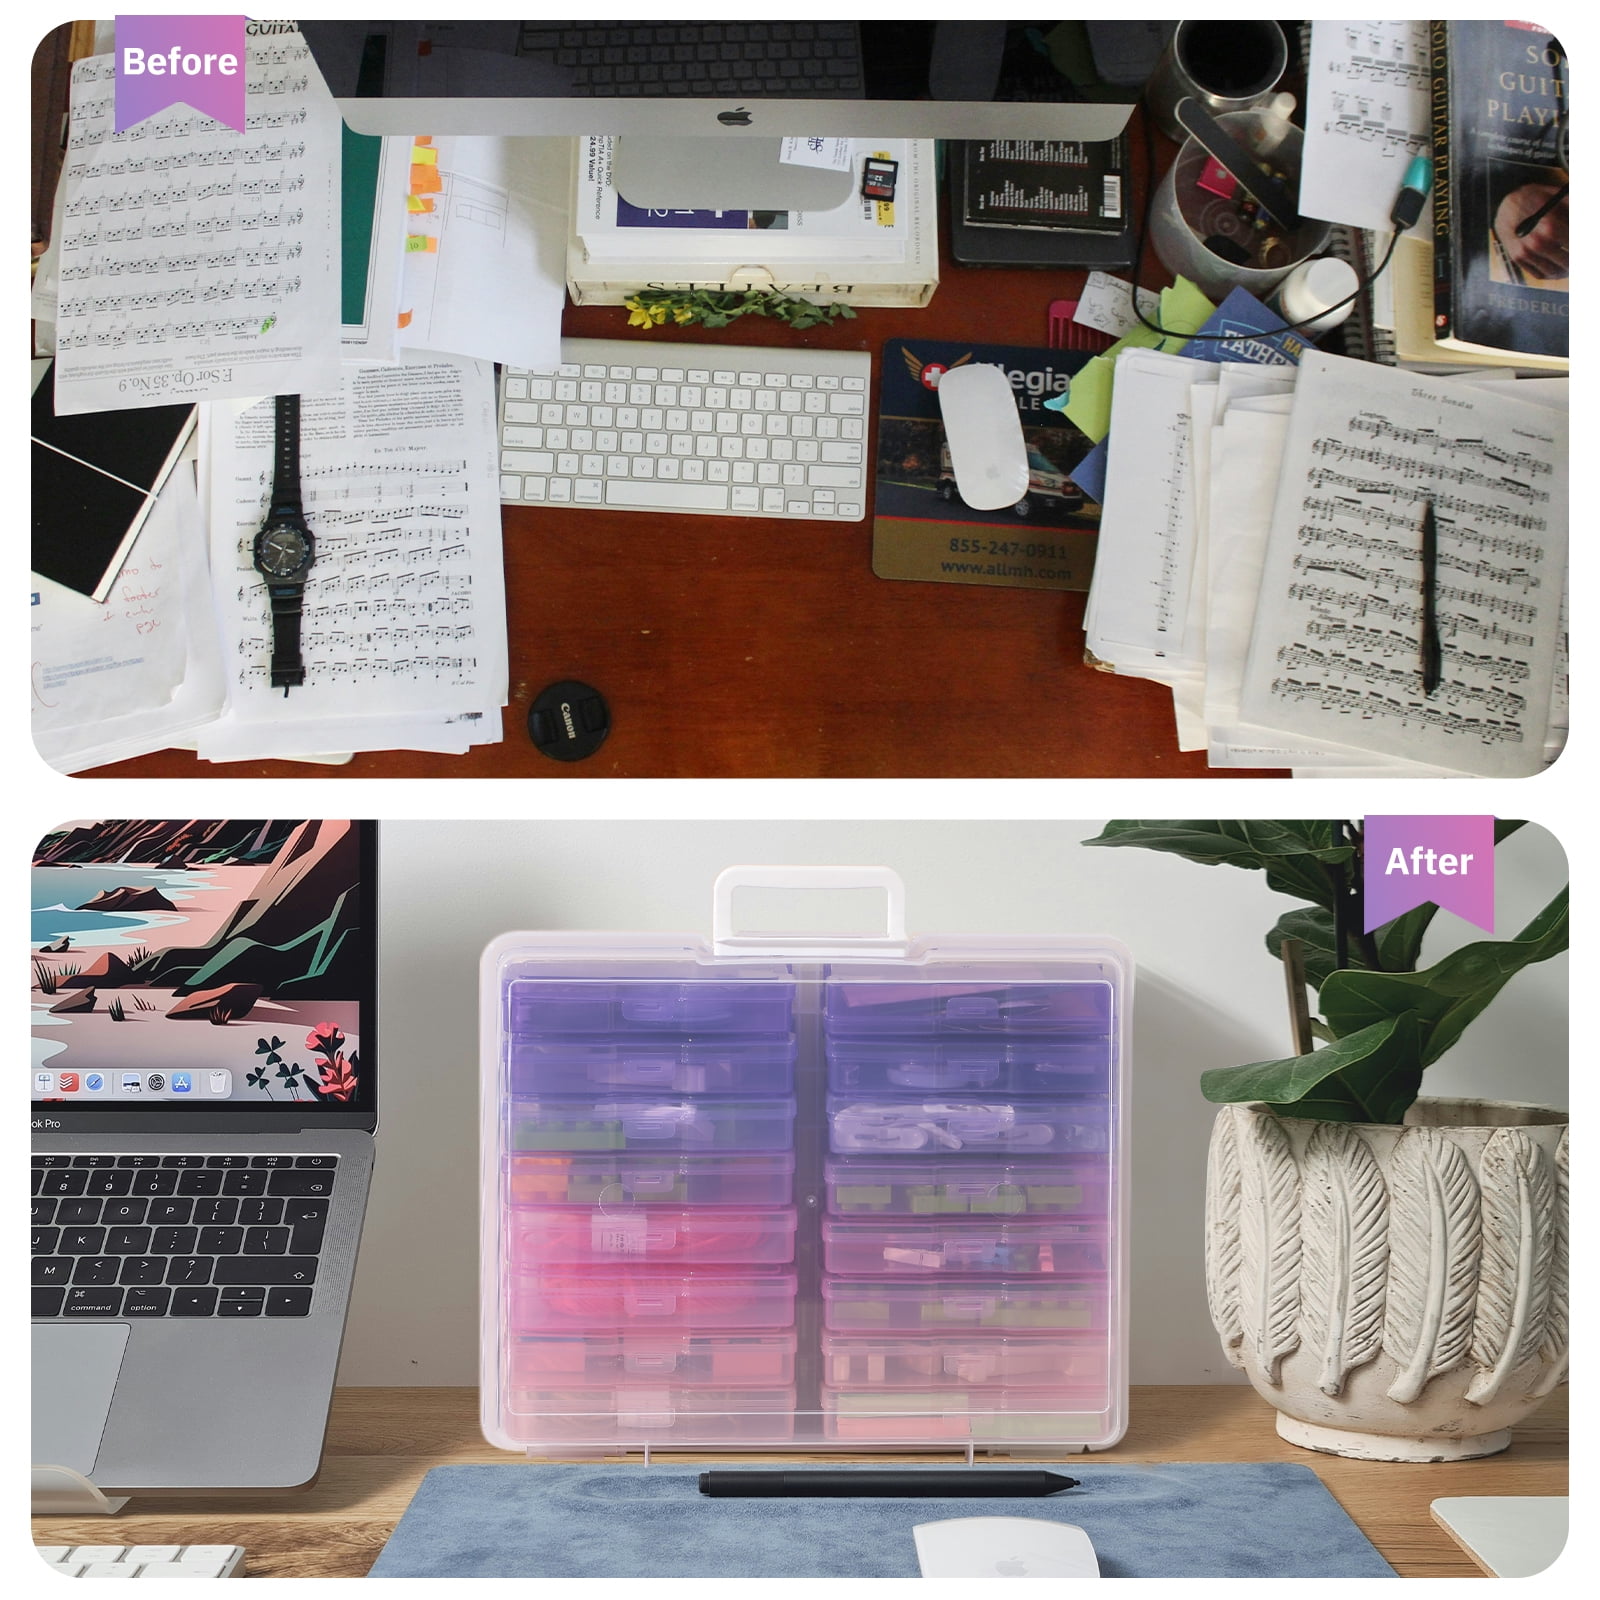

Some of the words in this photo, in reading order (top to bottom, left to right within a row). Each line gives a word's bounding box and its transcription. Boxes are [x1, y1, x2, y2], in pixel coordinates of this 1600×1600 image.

[246, 23, 301, 36] GUITA
[1432, 20, 1446, 69] SOLO
[1526, 45, 1568, 68] SO
[1500, 72, 1568, 98] GUIT
[1433, 78, 1448, 147] GUITAR
[1434, 155, 1450, 236] PLAYING
[128, 376, 150, 390] No.
[154, 374, 168, 388] 35
[171, 372, 196, 386] Op.
[199, 370, 220, 384] Sor
[222, 368, 232, 382] F.
[119, 380, 127, 392] 9
[950, 538, 1067, 559] 855-247-0911
[941, 560, 1072, 580] www.allmh.com
[560, 702, 576, 739] Canon
[45, 1119, 61, 1129] Pro
